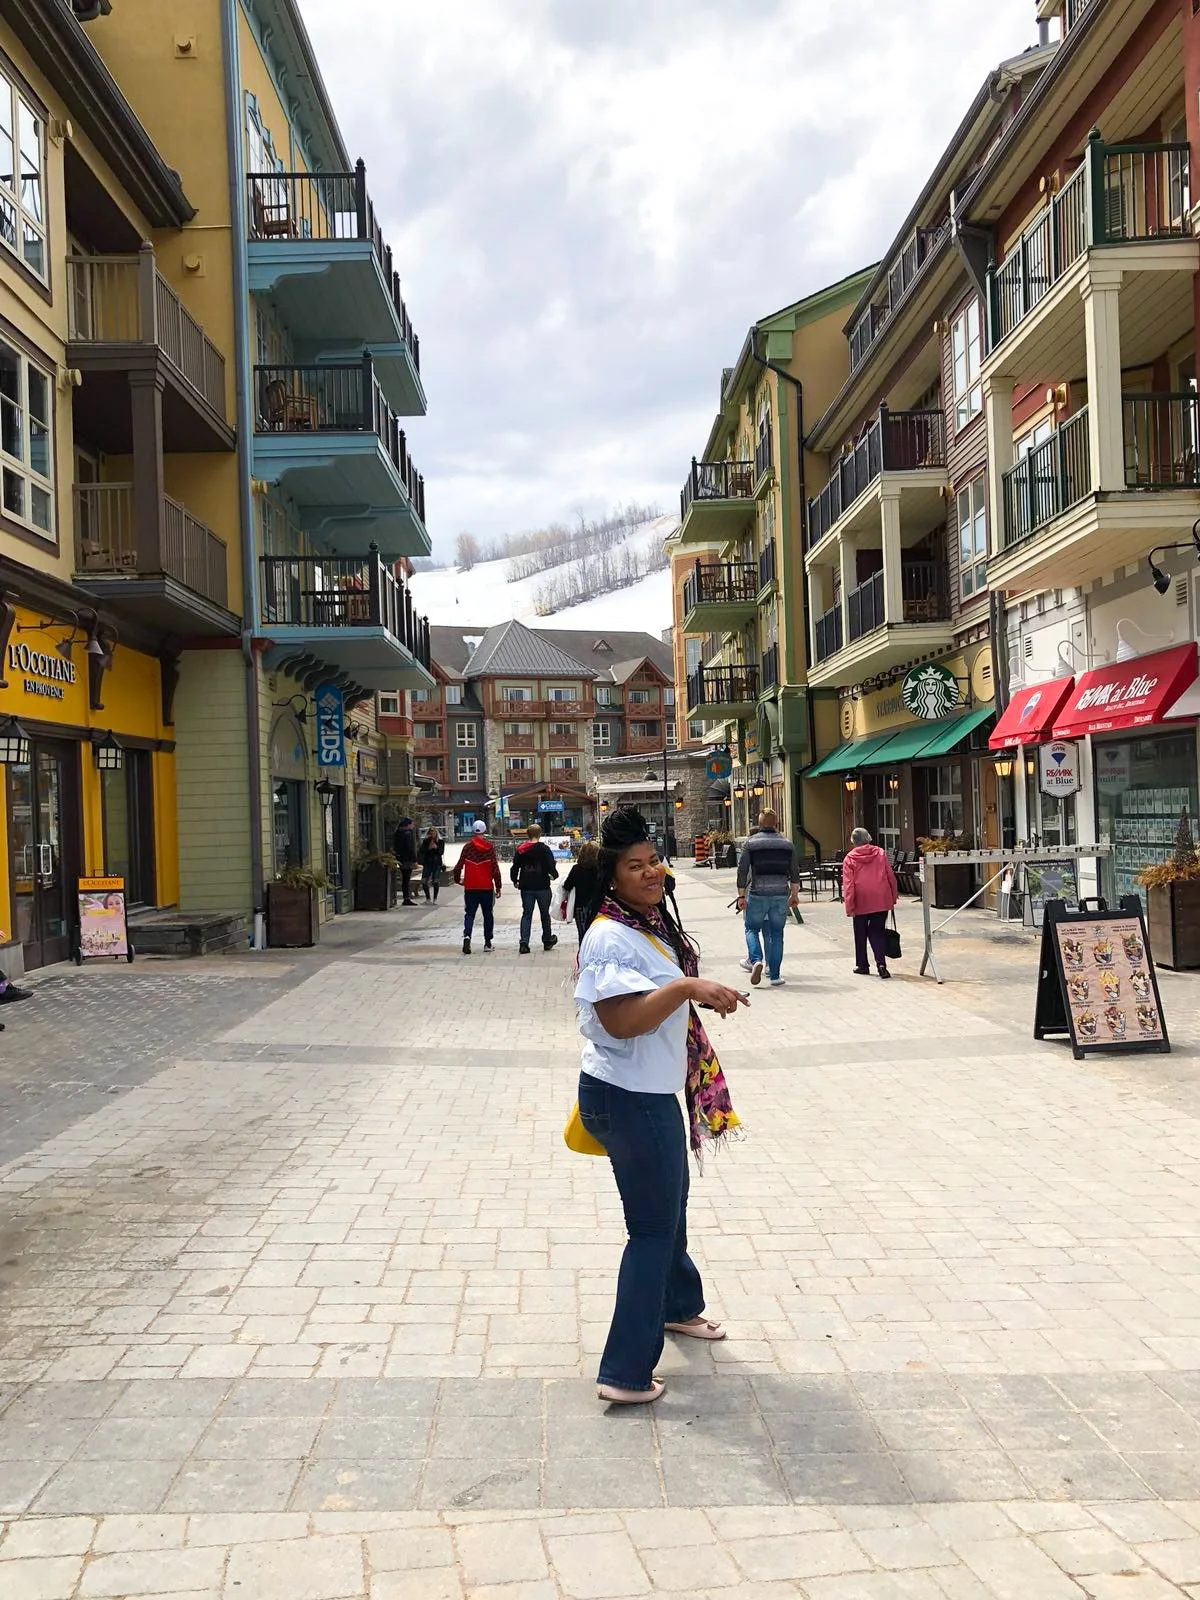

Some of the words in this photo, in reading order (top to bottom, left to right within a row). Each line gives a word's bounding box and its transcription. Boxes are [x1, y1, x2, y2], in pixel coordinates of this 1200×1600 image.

[9, 643, 76, 684] L'OCCITANE
[25, 679, 35, 692] EN
[36, 682, 64, 698] PROVENCE
[1110, 685, 1126, 702] at
[1123, 674, 1158, 700] Blue
